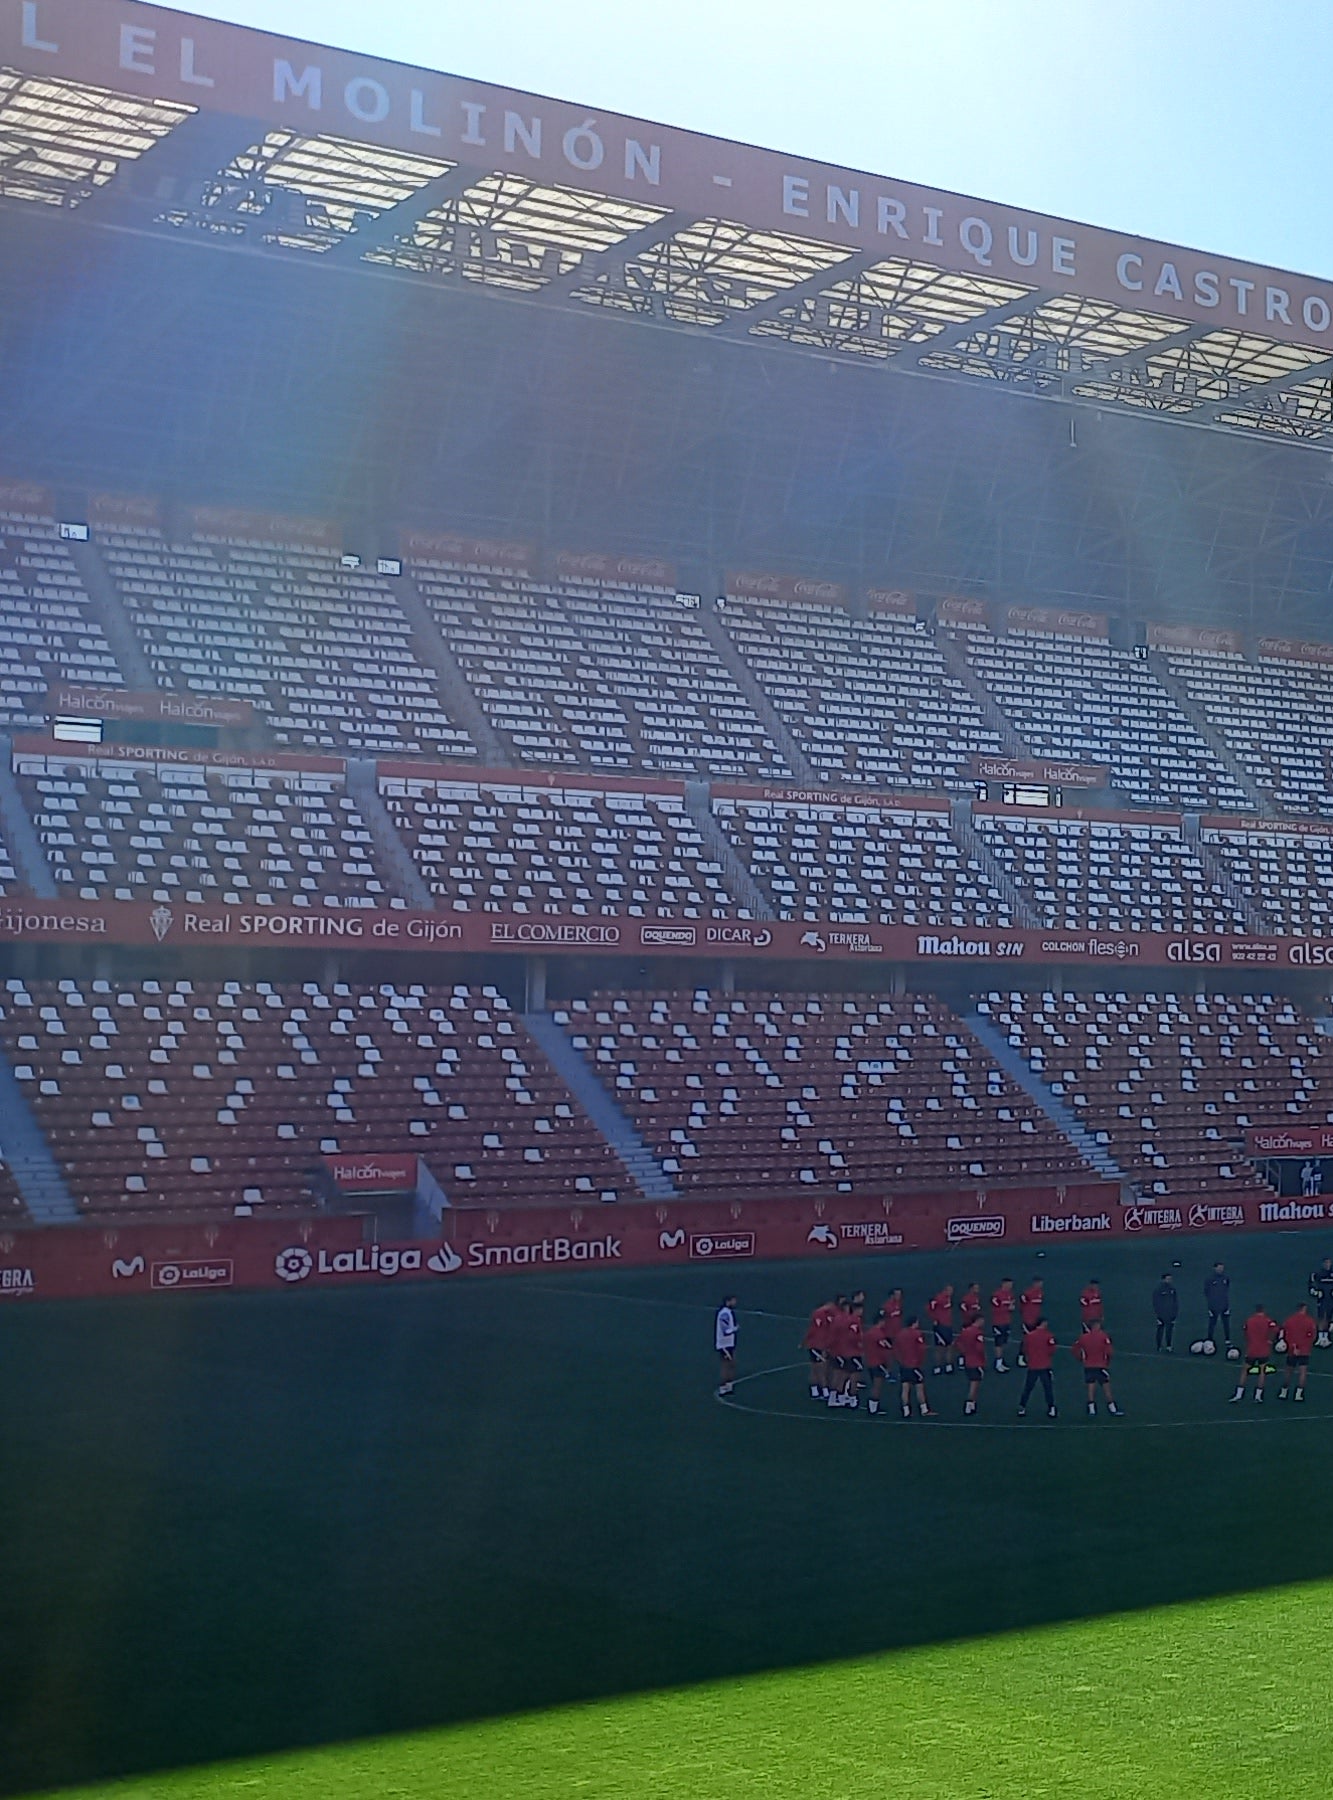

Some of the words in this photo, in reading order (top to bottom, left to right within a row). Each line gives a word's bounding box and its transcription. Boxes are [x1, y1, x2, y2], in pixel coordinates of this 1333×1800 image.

[22, 3, 58, 54] L
[118, 22, 214, 88] EL
[272, 58, 662, 187] MOLINÓN
[783, 174, 1078, 276] ENRIQUE
[1117, 253, 1332, 332] CASTRO
[59, 692, 115, 711] Halcón
[160, 699, 213, 719] Halcón
[118, 746, 188, 761] SPORTING
[786, 790, 837, 803] SPORTING
[1258, 821, 1297, 832] SPORTING
[0, 906, 107, 936] ijonesa
[184, 914, 231, 934] Real
[239, 916, 363, 937] SPORTING
[372, 918, 399, 938] de
[406, 918, 462, 943] Gijón
[491, 922, 513, 940] EL
[513, 923, 620, 943] COMERCIO
[643, 929, 693, 942] OQUENDO
[706, 927, 751, 941] DICAR
[828, 932, 870, 945] TERNERA
[918, 935, 991, 956] Mahou
[996, 942, 1024, 956] SIN
[1167, 941, 1219, 963] alsa
[334, 1162, 381, 1181] Halcón
[1144, 1208, 1182, 1225] INTEGRA
[1207, 1205, 1244, 1222] INTEGRA
[1259, 1202, 1324, 1222] Mahou
[840, 1223, 888, 1238] TERNERA
[950, 1221, 1001, 1236] OQUENDO
[1031, 1213, 1111, 1232] Liberbank
[468, 1235, 621, 1267] SmartBank
[715, 1239, 750, 1252] LaLiga
[319, 1246, 421, 1276] LaLiga
[183, 1266, 227, 1281] LaLiga
